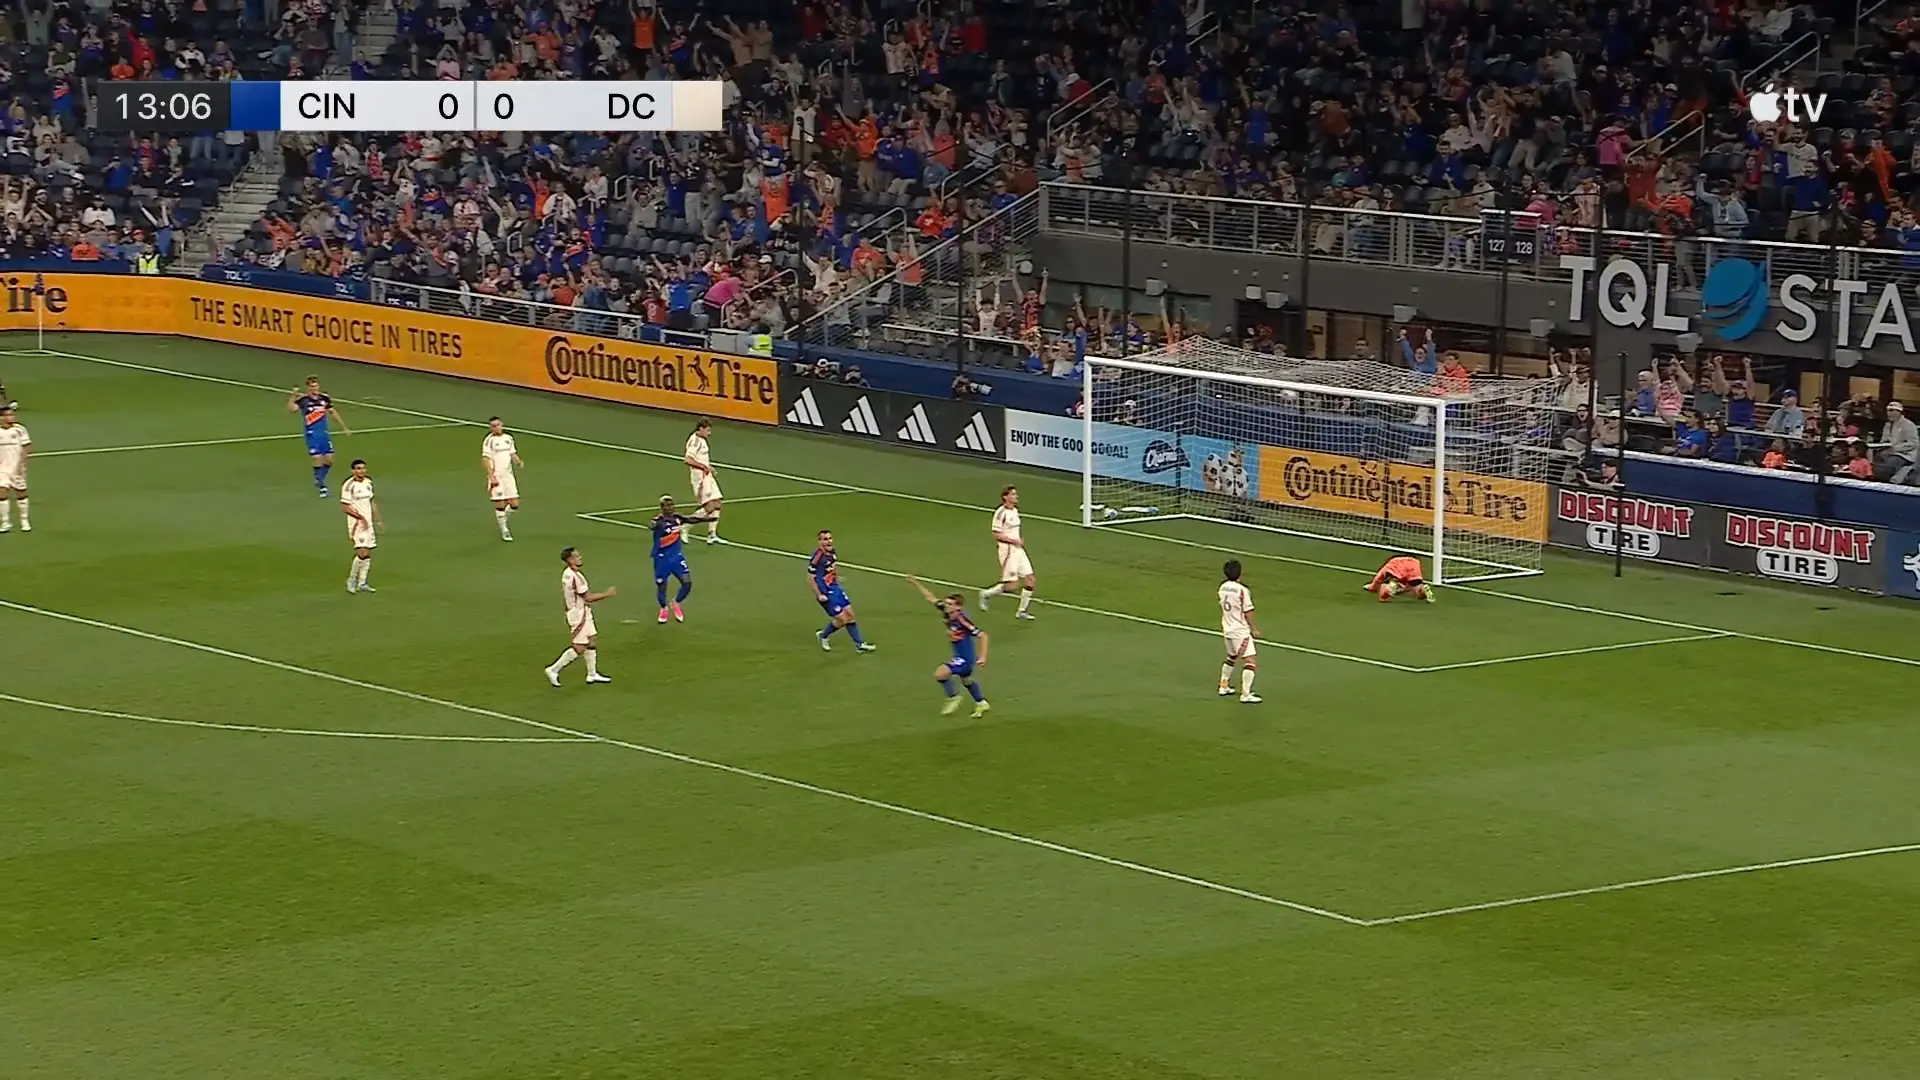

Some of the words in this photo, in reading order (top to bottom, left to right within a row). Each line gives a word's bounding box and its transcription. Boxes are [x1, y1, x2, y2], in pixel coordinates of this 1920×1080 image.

[1488, 239, 1505, 252] 127
[1515, 241, 1533, 254] 128
[0, 277, 67, 313] ire
[1560, 255, 1689, 330] TQL
[1776, 274, 1917, 353] STA
[190, 297, 226, 324] THE
[233, 303, 294, 334] SMART
[302, 313, 374, 346] CHOICE
[381, 324, 400, 349] IN
[407, 327, 462, 358] TIRES
[546, 336, 688, 393] Continental
[708, 357, 774, 404] Tire
[1011, 429, 1040, 447] ENJOY
[1041, 434, 1060, 448] THE
[1283, 456, 1435, 510] Continental
[1457, 480, 1527, 521] Tire
[1560, 490, 1690, 537] DISCOUNT
[1595, 526, 1651, 552] TIRE
[1727, 513, 1871, 562] DISCOUNT
[1765, 552, 1828, 577] TIRE
[1223, 595, 1232, 612] 6
